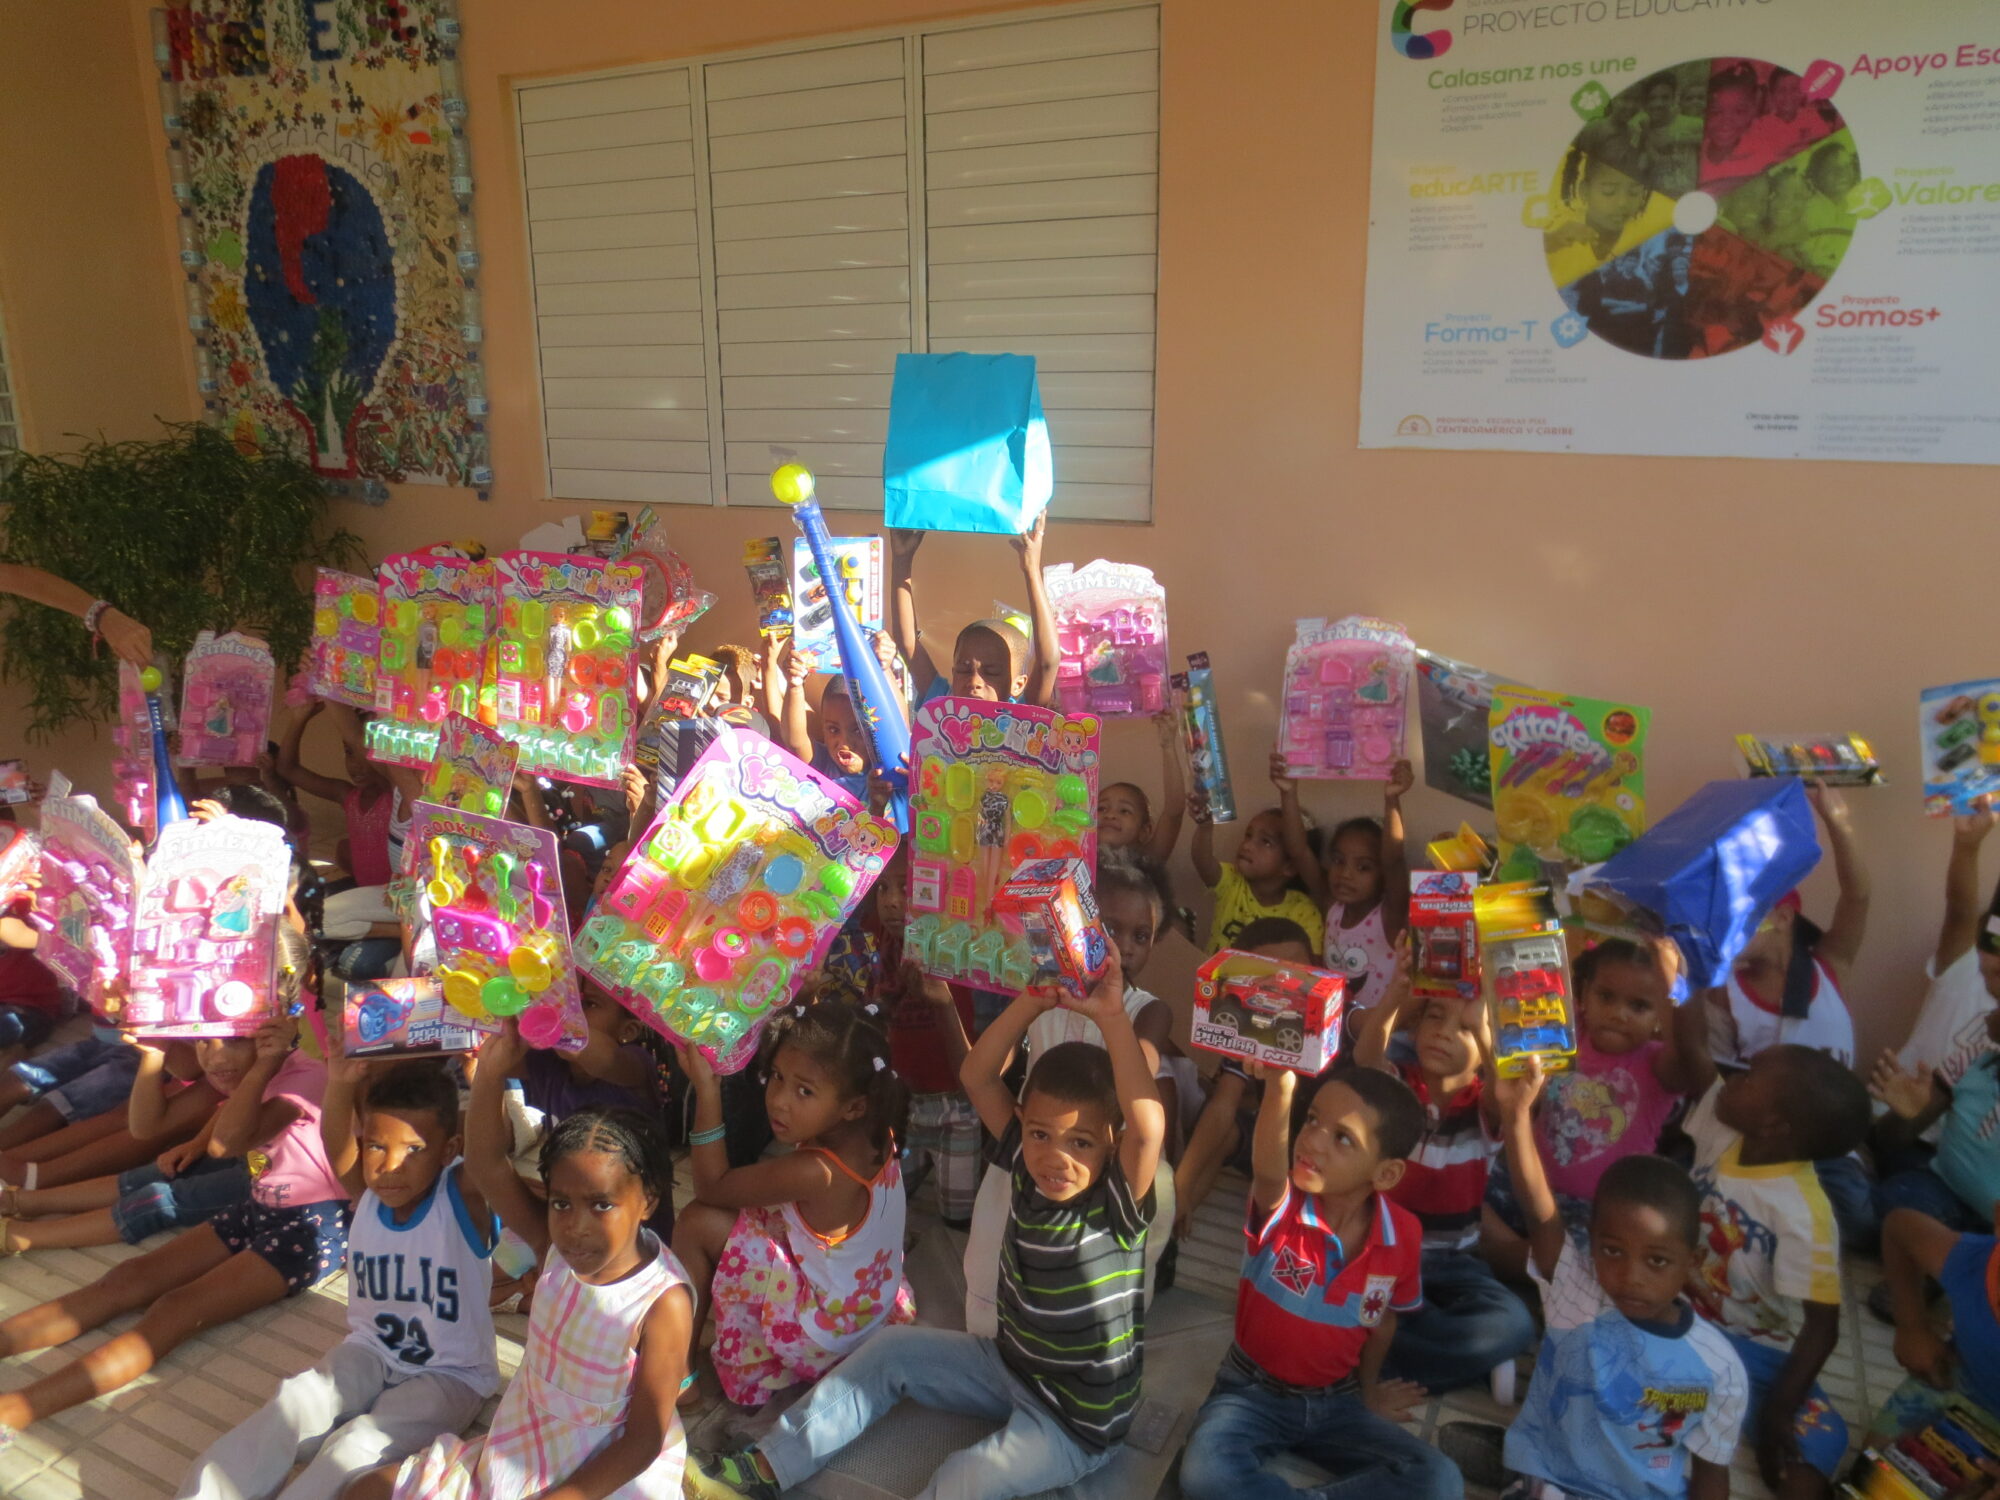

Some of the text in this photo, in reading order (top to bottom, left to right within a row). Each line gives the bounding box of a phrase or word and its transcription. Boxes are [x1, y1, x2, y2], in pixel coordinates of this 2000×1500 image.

[1463, 0, 1774, 36] PROYECTO EDUCA
[1427, 55, 1638, 90] Calasanz nos une
[1850, 52, 1949, 80] Apoyo
[1409, 170, 1539, 199] educARTE
[1842, 295, 1901, 307] Proyecto
[1816, 303, 1942, 328] Somos+
[1424, 320, 1540, 344] Forma-T
[1052, 571, 1149, 598] FITMENT
[1491, 707, 1609, 764] Kitchen
[422, 820, 502, 854] COOKING
